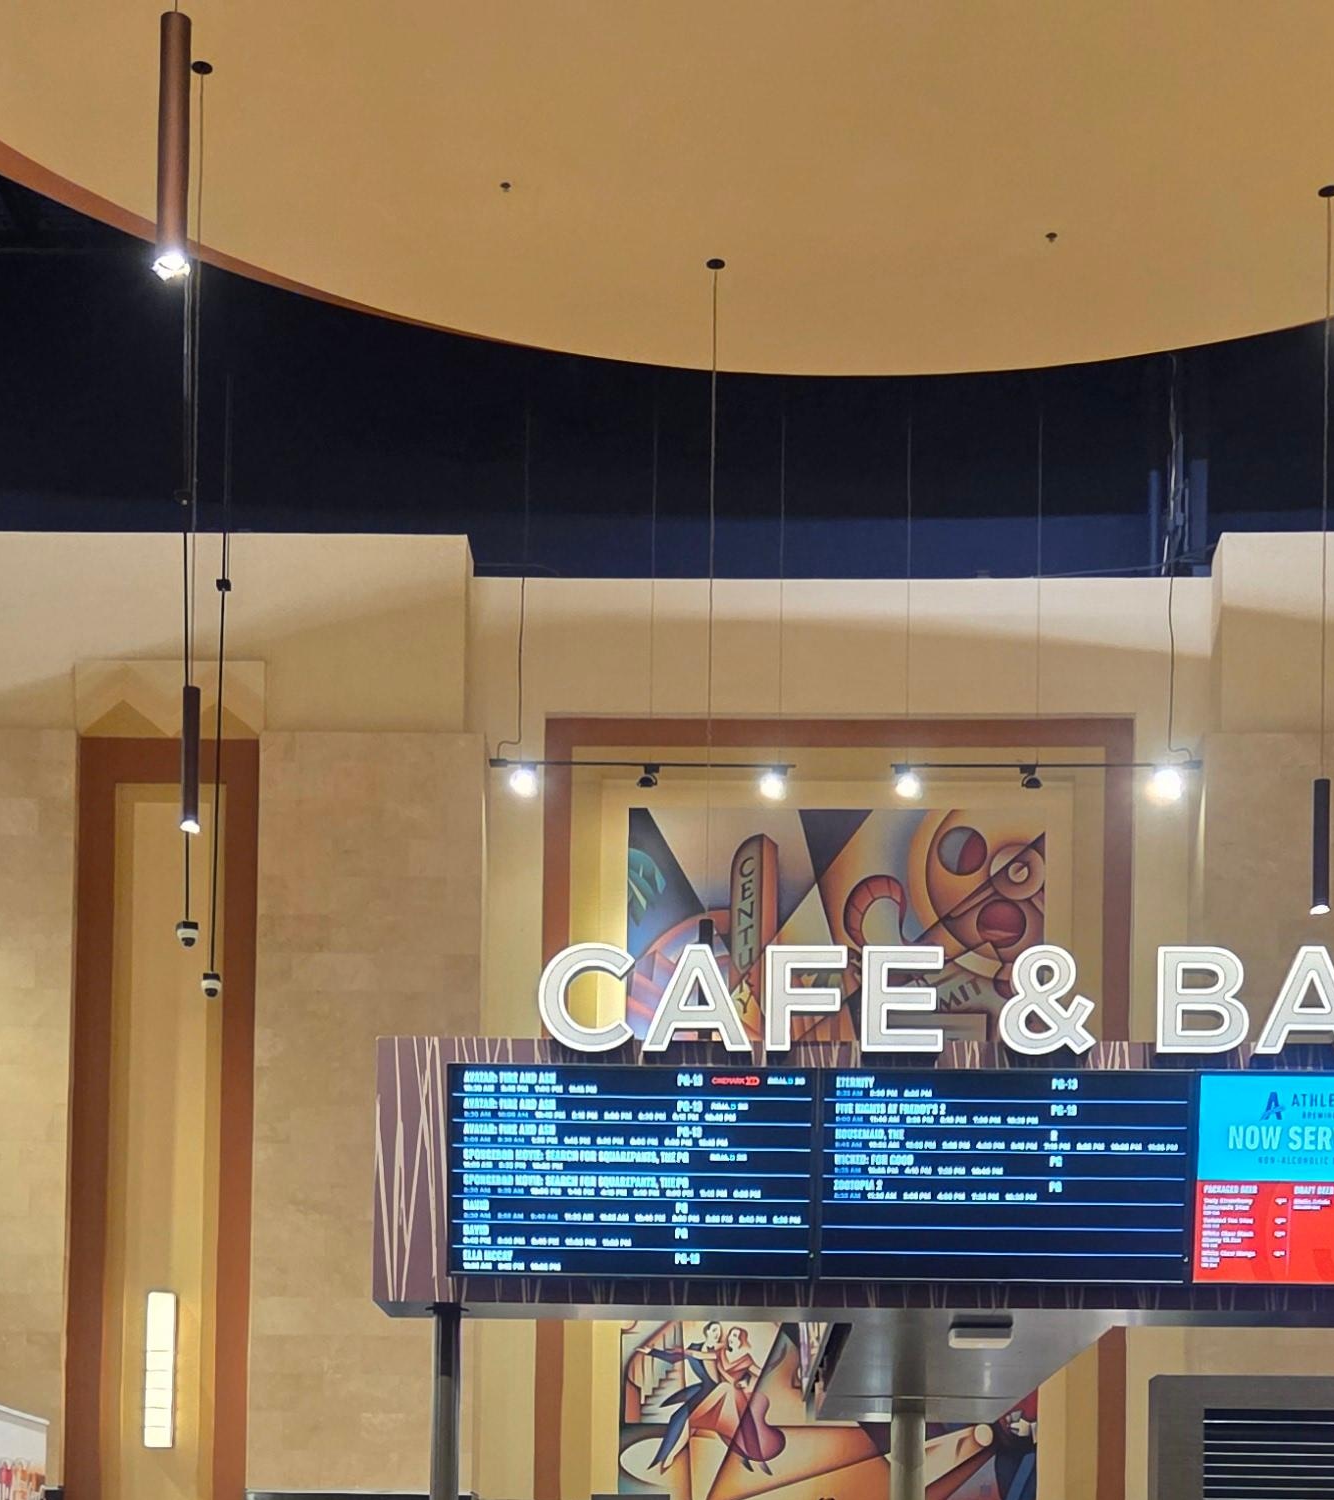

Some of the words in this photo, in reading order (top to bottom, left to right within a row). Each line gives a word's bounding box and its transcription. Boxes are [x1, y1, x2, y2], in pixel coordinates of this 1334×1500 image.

[537, 942, 944, 1053] CAFE
[998, 944, 1095, 1053] &
[939, 978, 981, 1010] MIT
[1228, 1125, 1280, 1150] NOW
